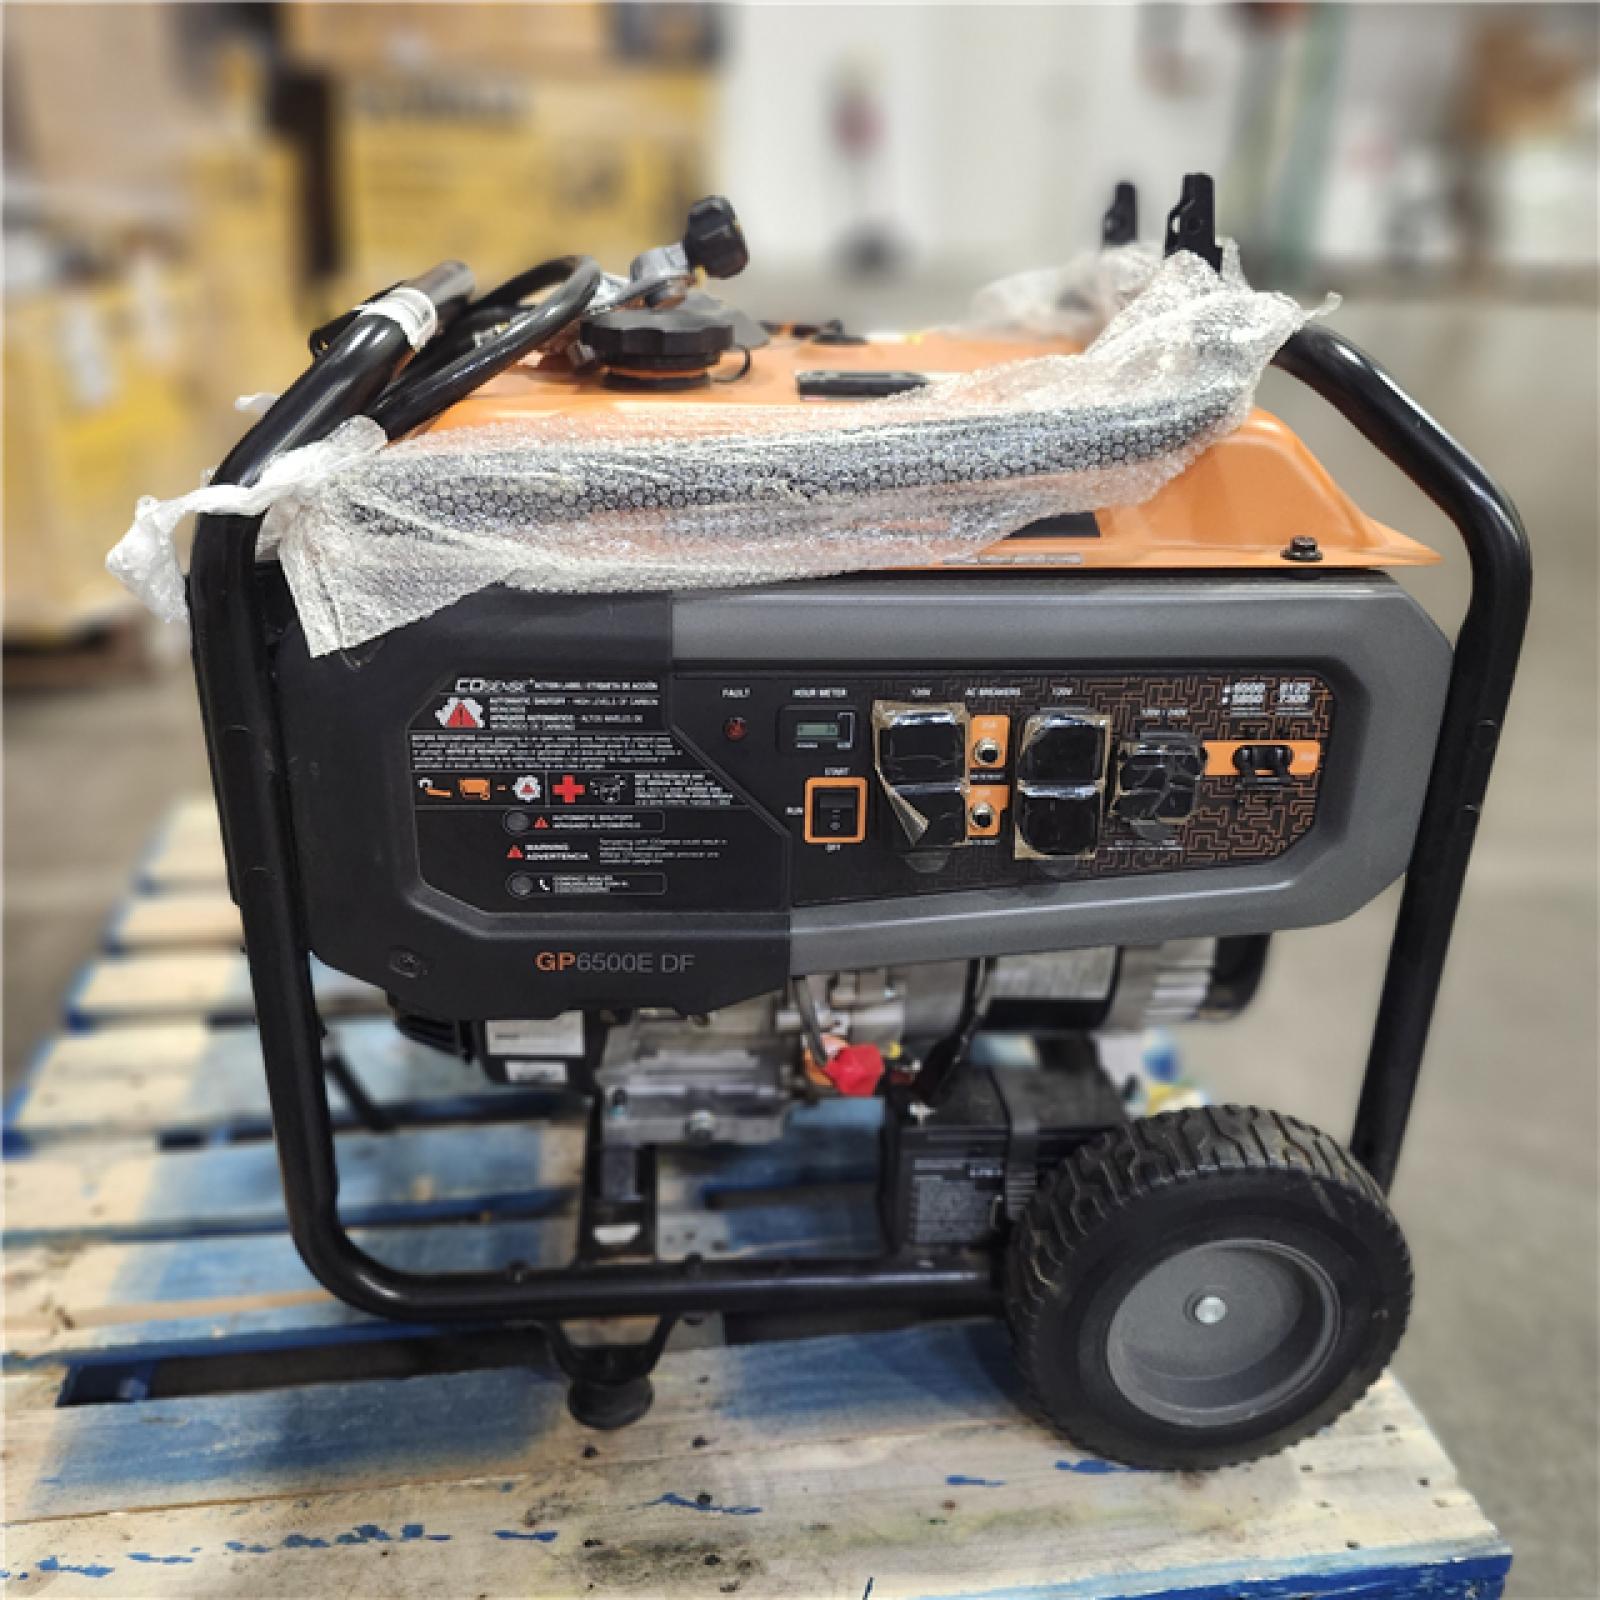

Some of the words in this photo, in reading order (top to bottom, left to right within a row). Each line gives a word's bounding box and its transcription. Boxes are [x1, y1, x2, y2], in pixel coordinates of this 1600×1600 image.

[721, 688, 750, 697] FAULT
[793, 688, 816, 697] HOUR
[819, 688, 847, 697] METER
[534, 951, 653, 973] GP6500E
[661, 952, 695, 973] DF
